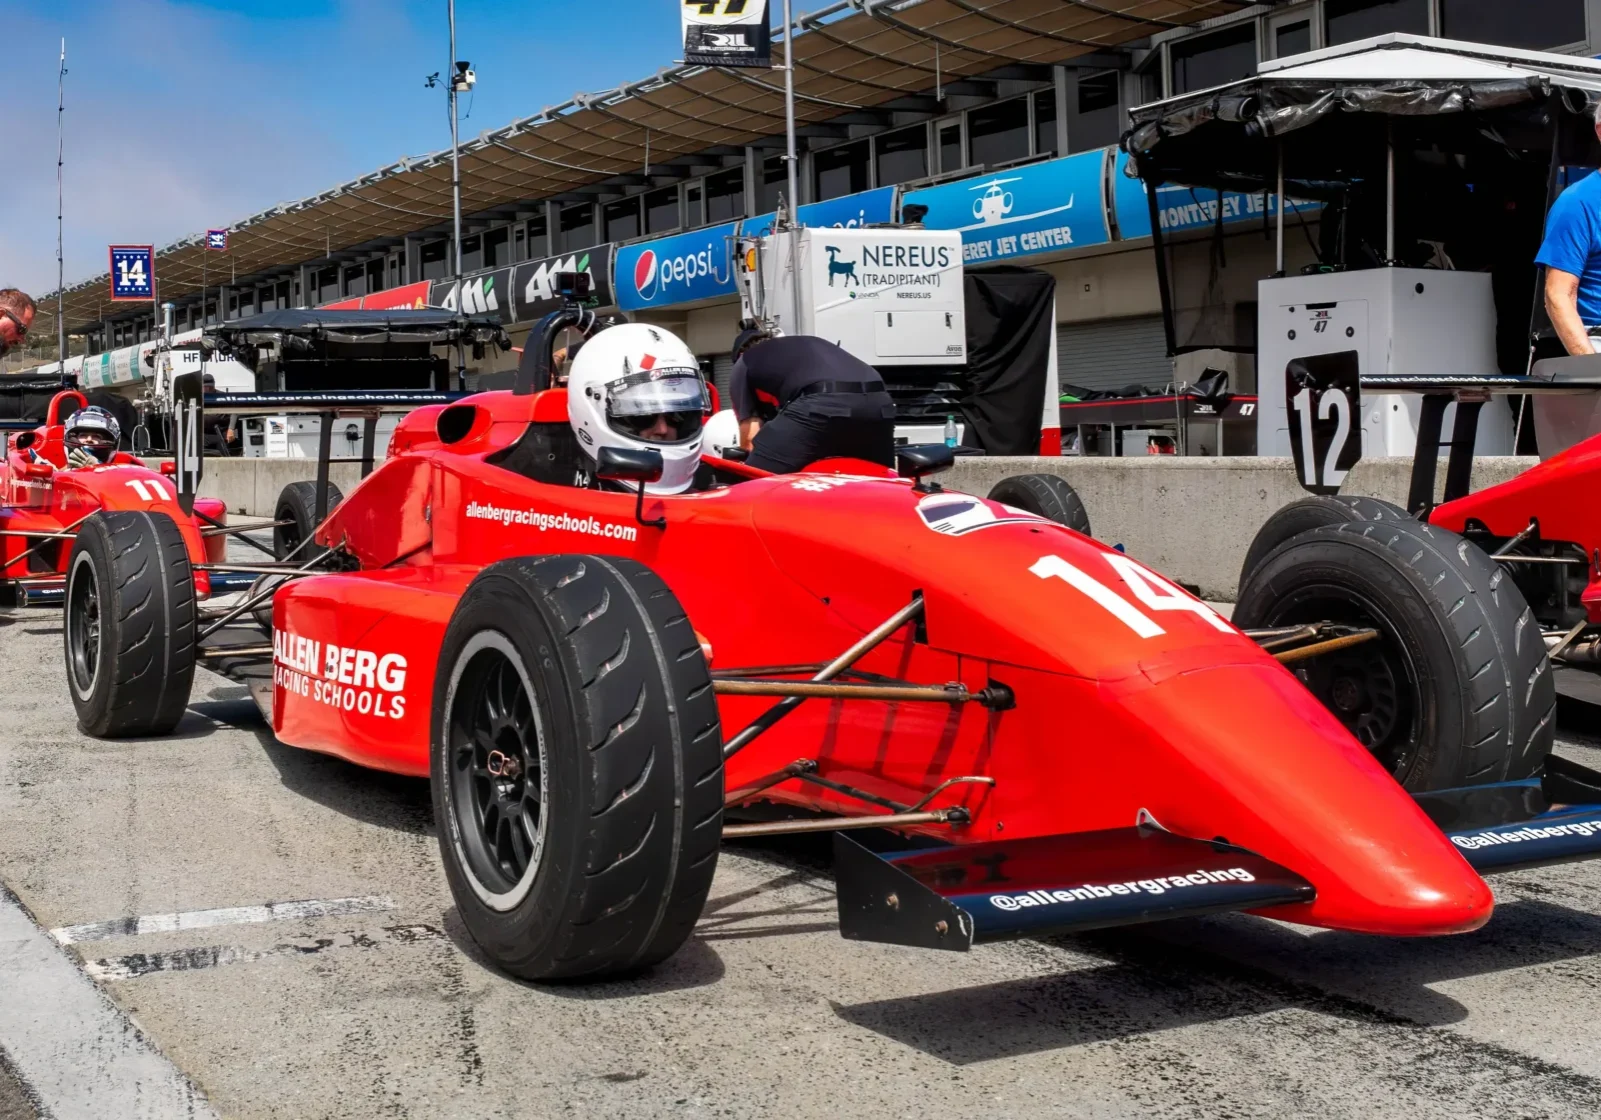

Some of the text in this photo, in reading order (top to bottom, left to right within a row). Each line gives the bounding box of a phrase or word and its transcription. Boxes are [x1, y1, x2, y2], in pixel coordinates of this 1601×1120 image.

[863, 245, 949, 267] NEREUS
[962, 226, 1074, 261] EREY JET CENTER
[117, 260, 147, 286] 14
[660, 244, 713, 292] pepsi
[862, 273, 940, 287] (TRADIPITANT)
[1313, 320, 1328, 333] 47
[216, 394, 447, 402] allenbergracingschools.com
[1239, 403, 1255, 416] 47
[174, 398, 199, 495] 14
[1293, 388, 1351, 487] 12
[125, 479, 171, 501] 11
[465, 501, 638, 542] allenbergracingschools.com
[1027, 552, 1239, 639] 14
[273, 629, 407, 692] ALLEN BERG
[314, 680, 406, 719] SCHOOLS
[989, 865, 1256, 911] @allenbergracing
